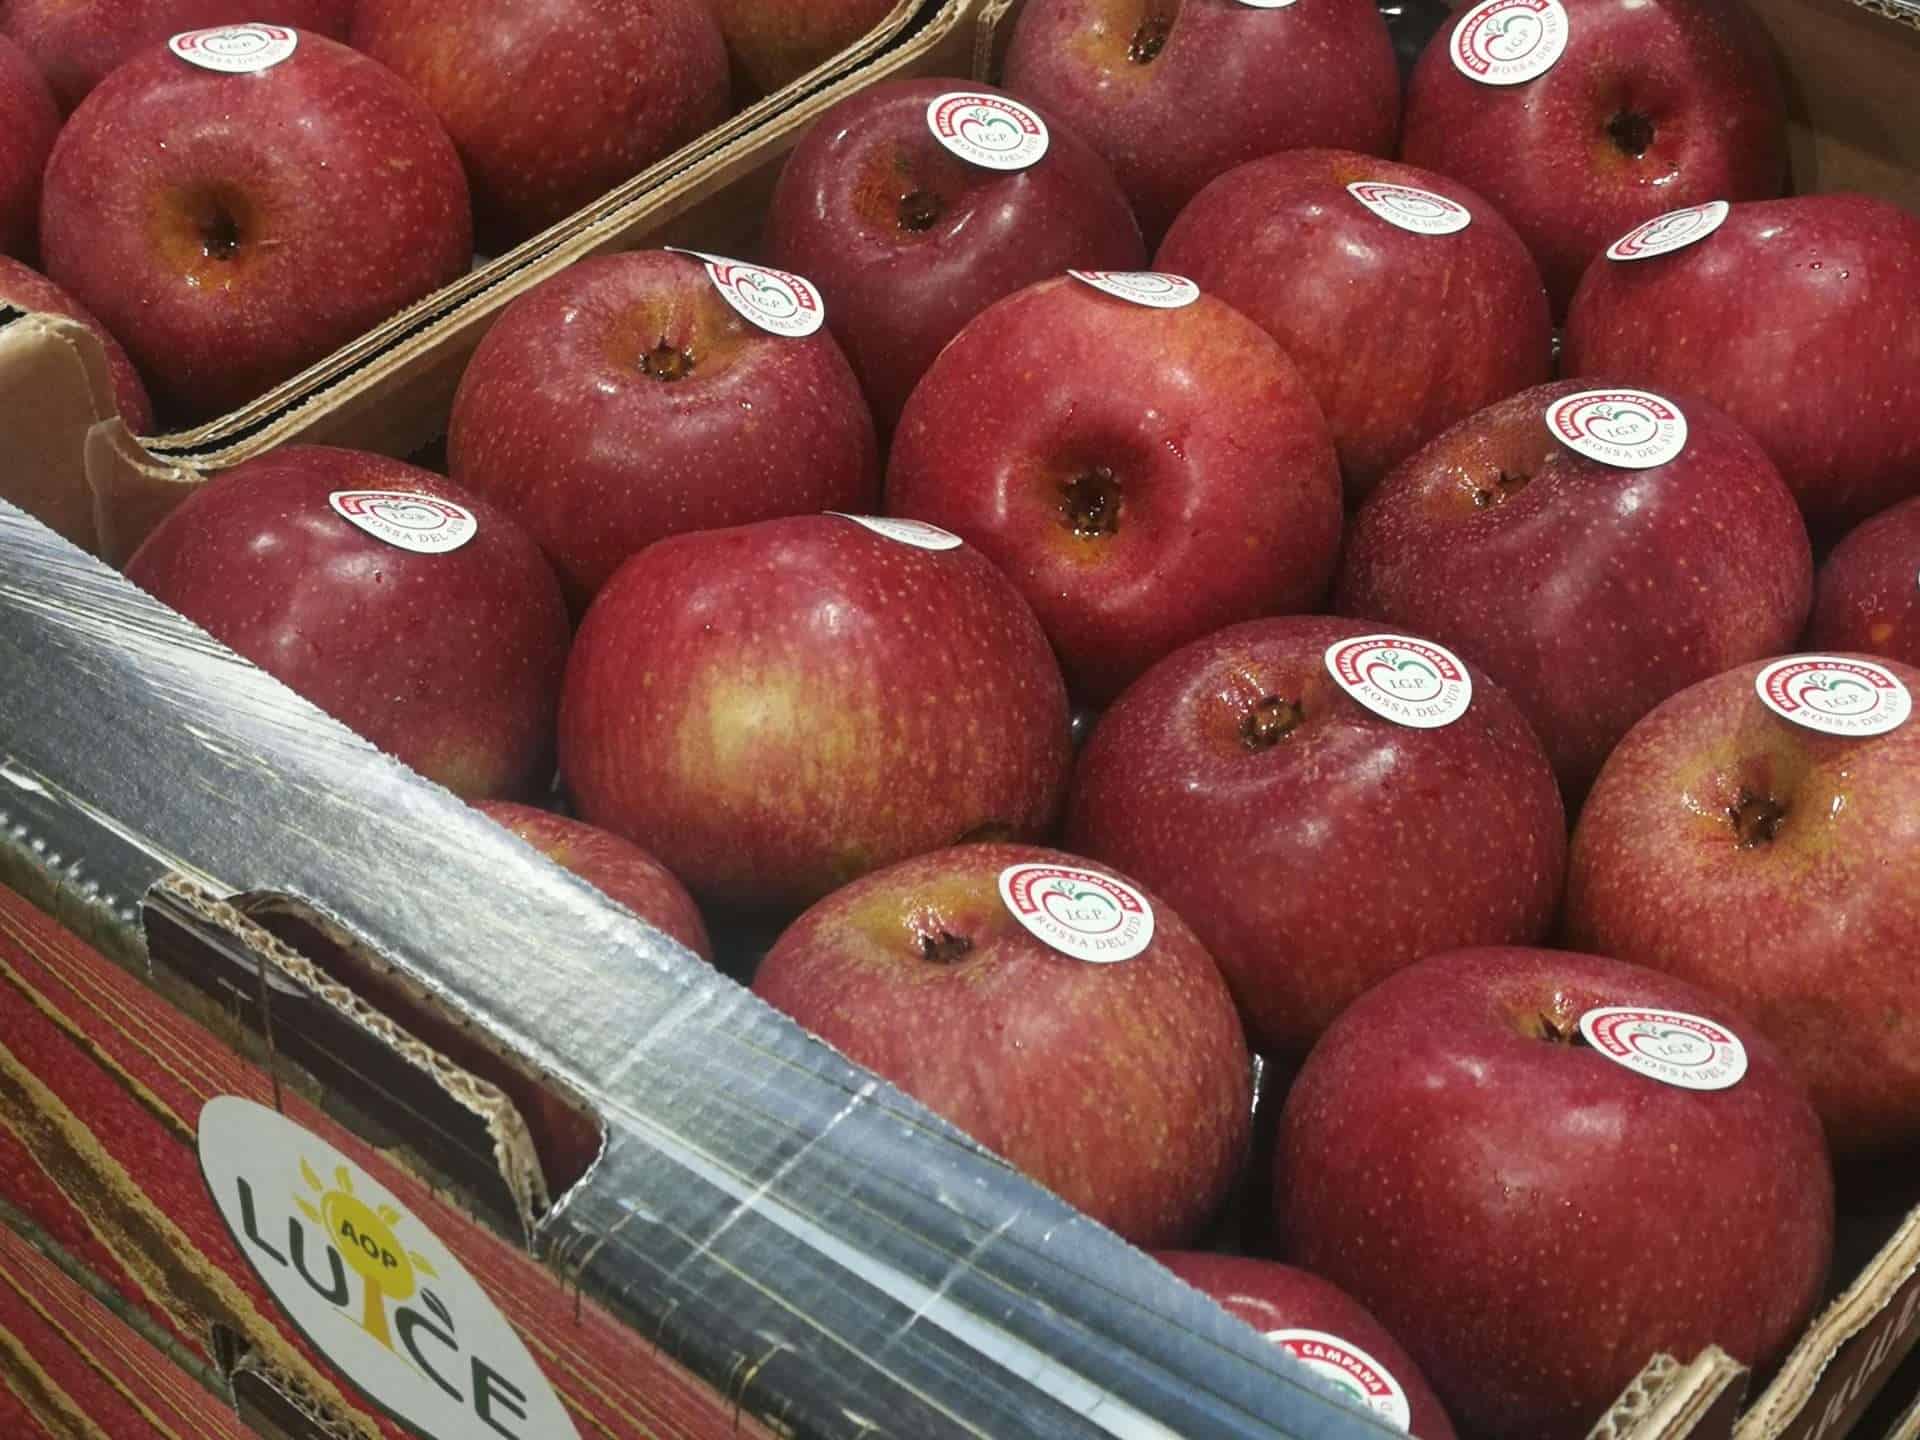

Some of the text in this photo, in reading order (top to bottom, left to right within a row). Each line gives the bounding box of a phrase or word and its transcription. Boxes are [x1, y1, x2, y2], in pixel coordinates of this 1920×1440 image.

[1604, 395, 1667, 418] CAMPANA
[1583, 437, 1633, 459] ROSSA
[1636, 444, 1665, 459] DEL
[418, 531, 449, 544] DEL
[1391, 640, 1456, 680] CAMPANA
[1815, 663, 1887, 688] CAMPANA
[1361, 684, 1411, 717] ROSSA
[1415, 705, 1447, 718] DEL
[1799, 710, 1857, 728] ROSSA
[1860, 712, 1889, 727] DEL
[1068, 871, 1136, 910] CAMPANA
[1034, 916, 1089, 948] ROSSA
[1095, 935, 1126, 950] DEL
[1643, 1015, 1721, 1042] CAMPANA
[1632, 1055, 1693, 1080] ROSSA
[1695, 1065, 1726, 1081] DEL
[341, 1220, 398, 1270] AOP
[1301, 1342, 1384, 1393] CAMPANA
